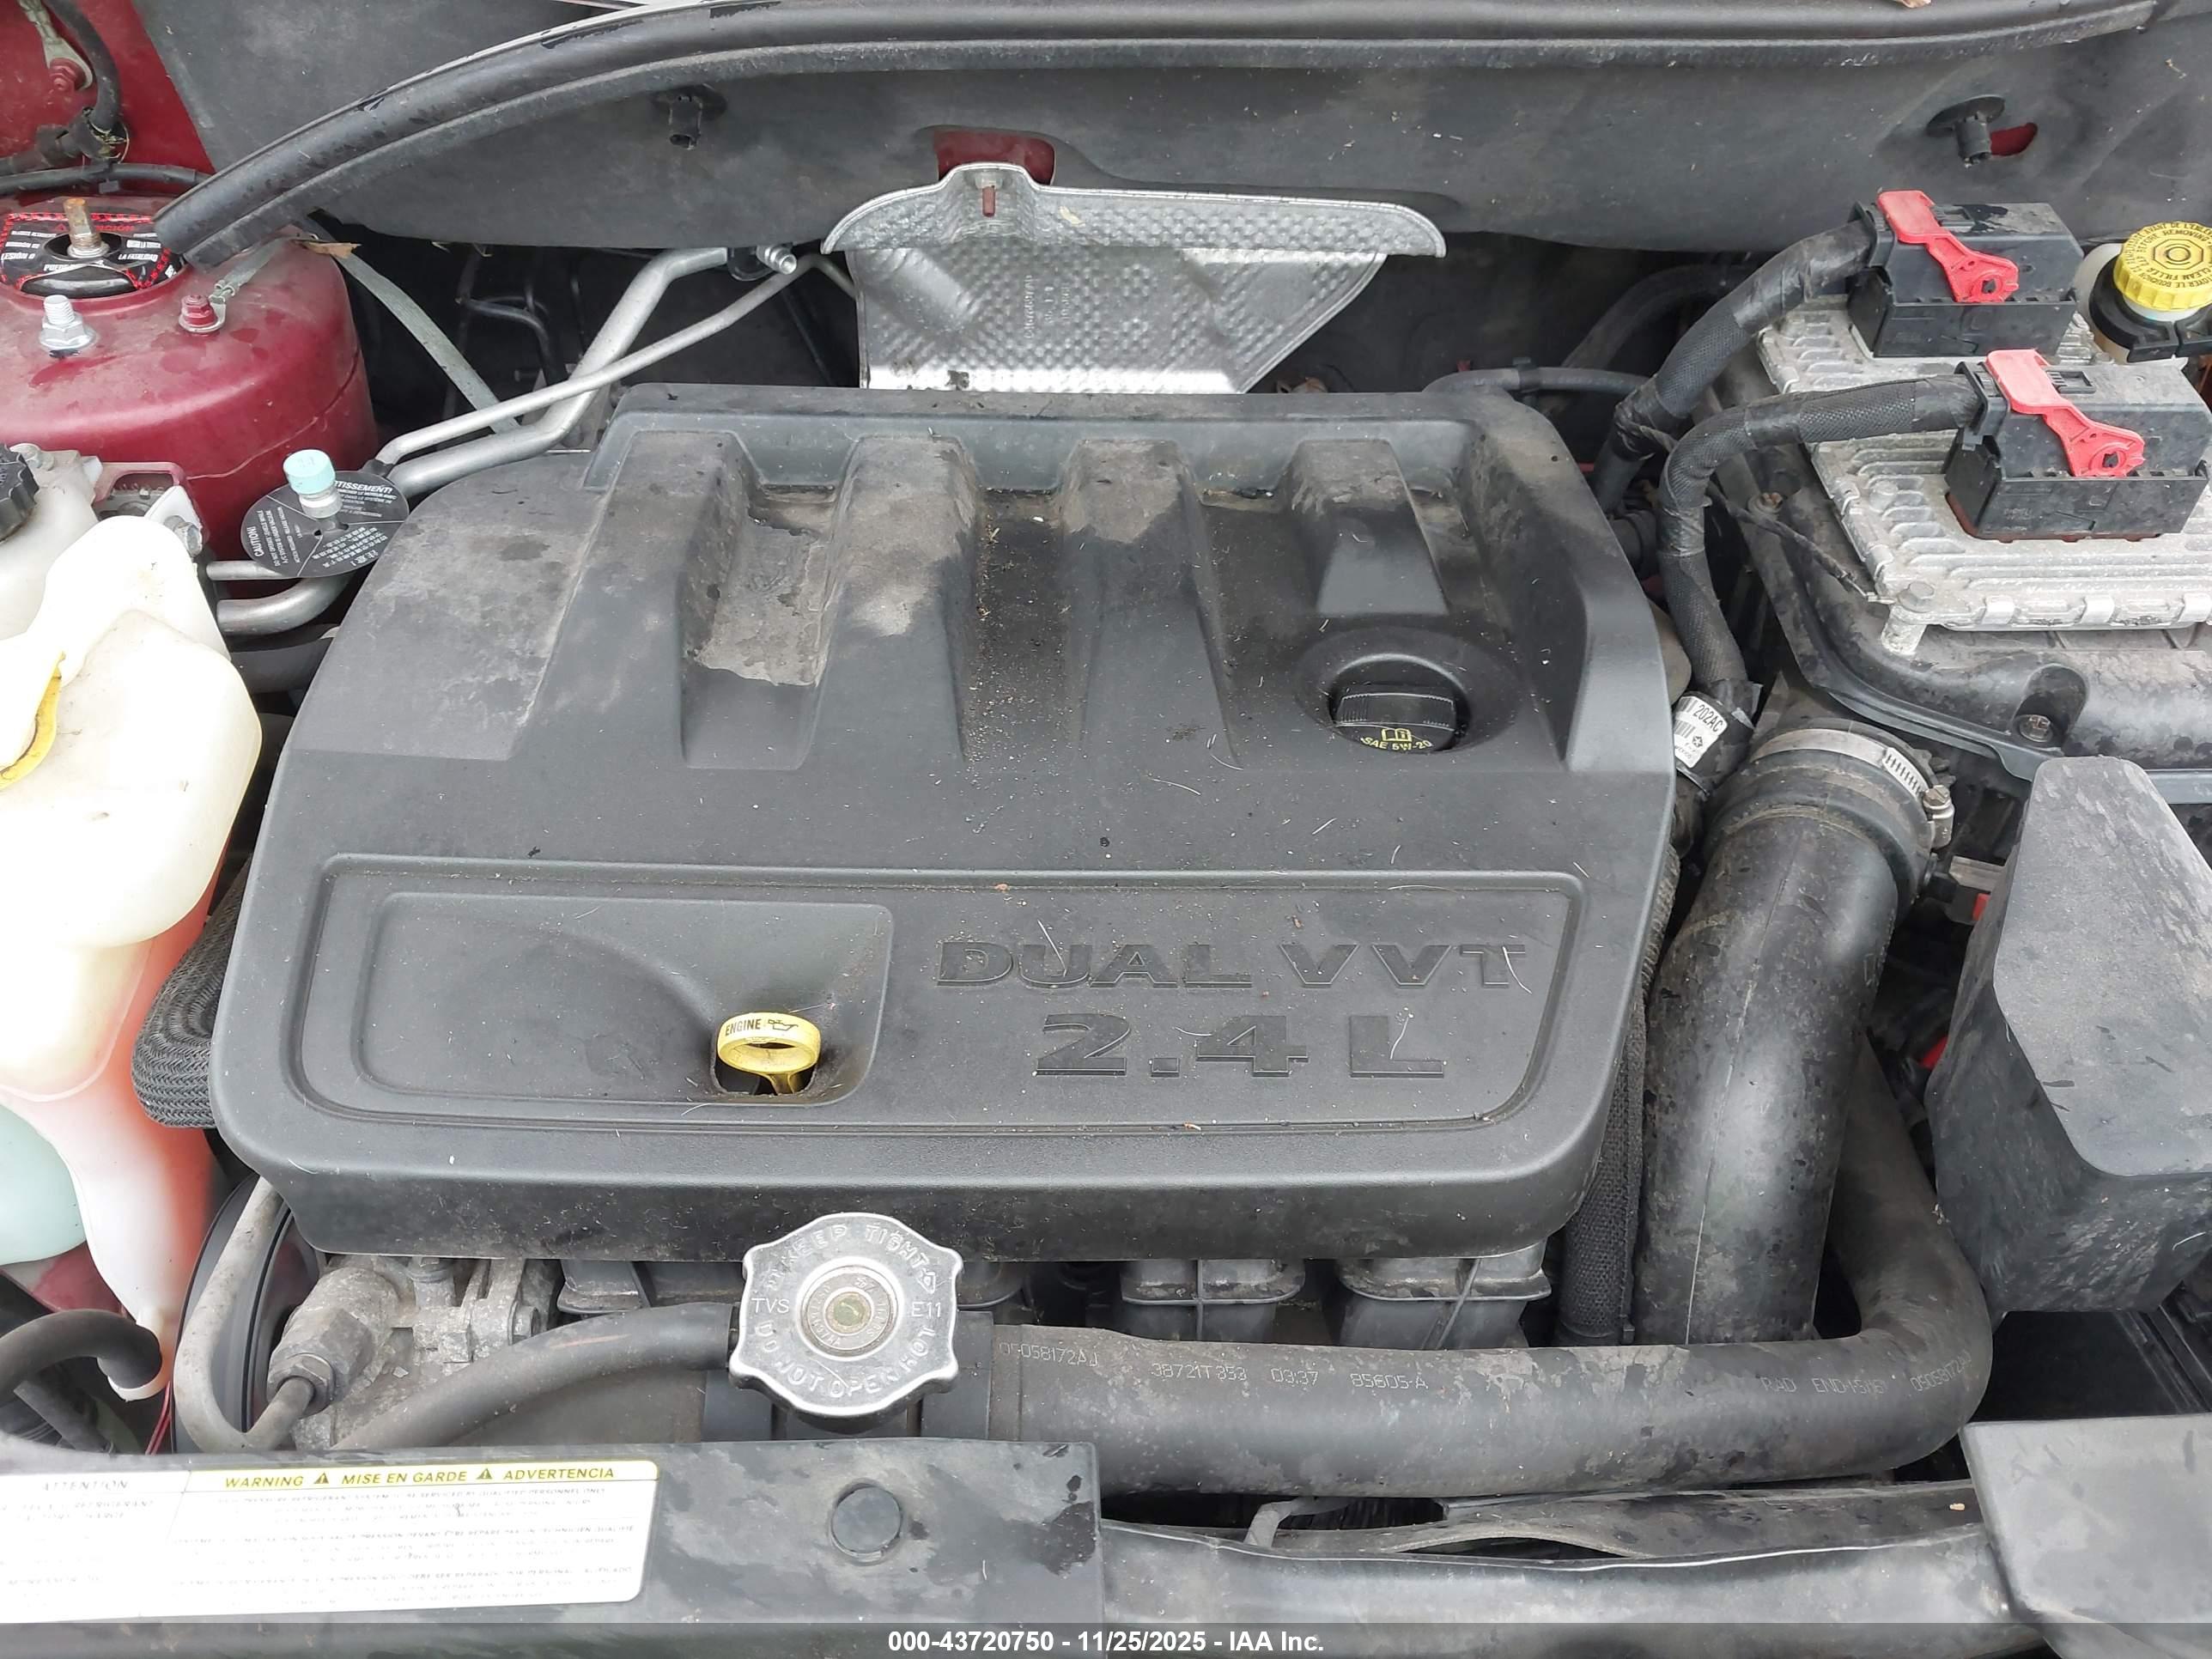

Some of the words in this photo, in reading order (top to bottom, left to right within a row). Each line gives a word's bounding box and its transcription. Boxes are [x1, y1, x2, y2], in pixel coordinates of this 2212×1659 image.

[335, 480, 393, 494] TISSEMENT!
[246, 526, 264, 557] CAUTION!
[1359, 736, 1389, 750] SAE
[1391, 738, 1433, 750] 5W-20
[937, 941, 1252, 989] DUAL
[1279, 943, 1526, 989] VVT
[725, 1018, 762, 1036] ENGINE
[1035, 1013, 1309, 1078] 2.4
[1350, 1014, 1444, 1079] L
[781, 1224, 848, 1271] KEEP
[865, 1223, 929, 1268] TIGHT
[750, 1297, 790, 1314] TVS
[911, 1302, 941, 1318] E11
[774, 1357, 824, 1391] NOT
[898, 1327, 935, 1373] HOT
[225, 1475, 304, 1488] WARNING
[341, 1473, 380, 1486] MISE
[386, 1472, 408, 1484] EN
[412, 1470, 468, 1483] GARDE
[503, 1468, 615, 1480] ADVERTENCIA
